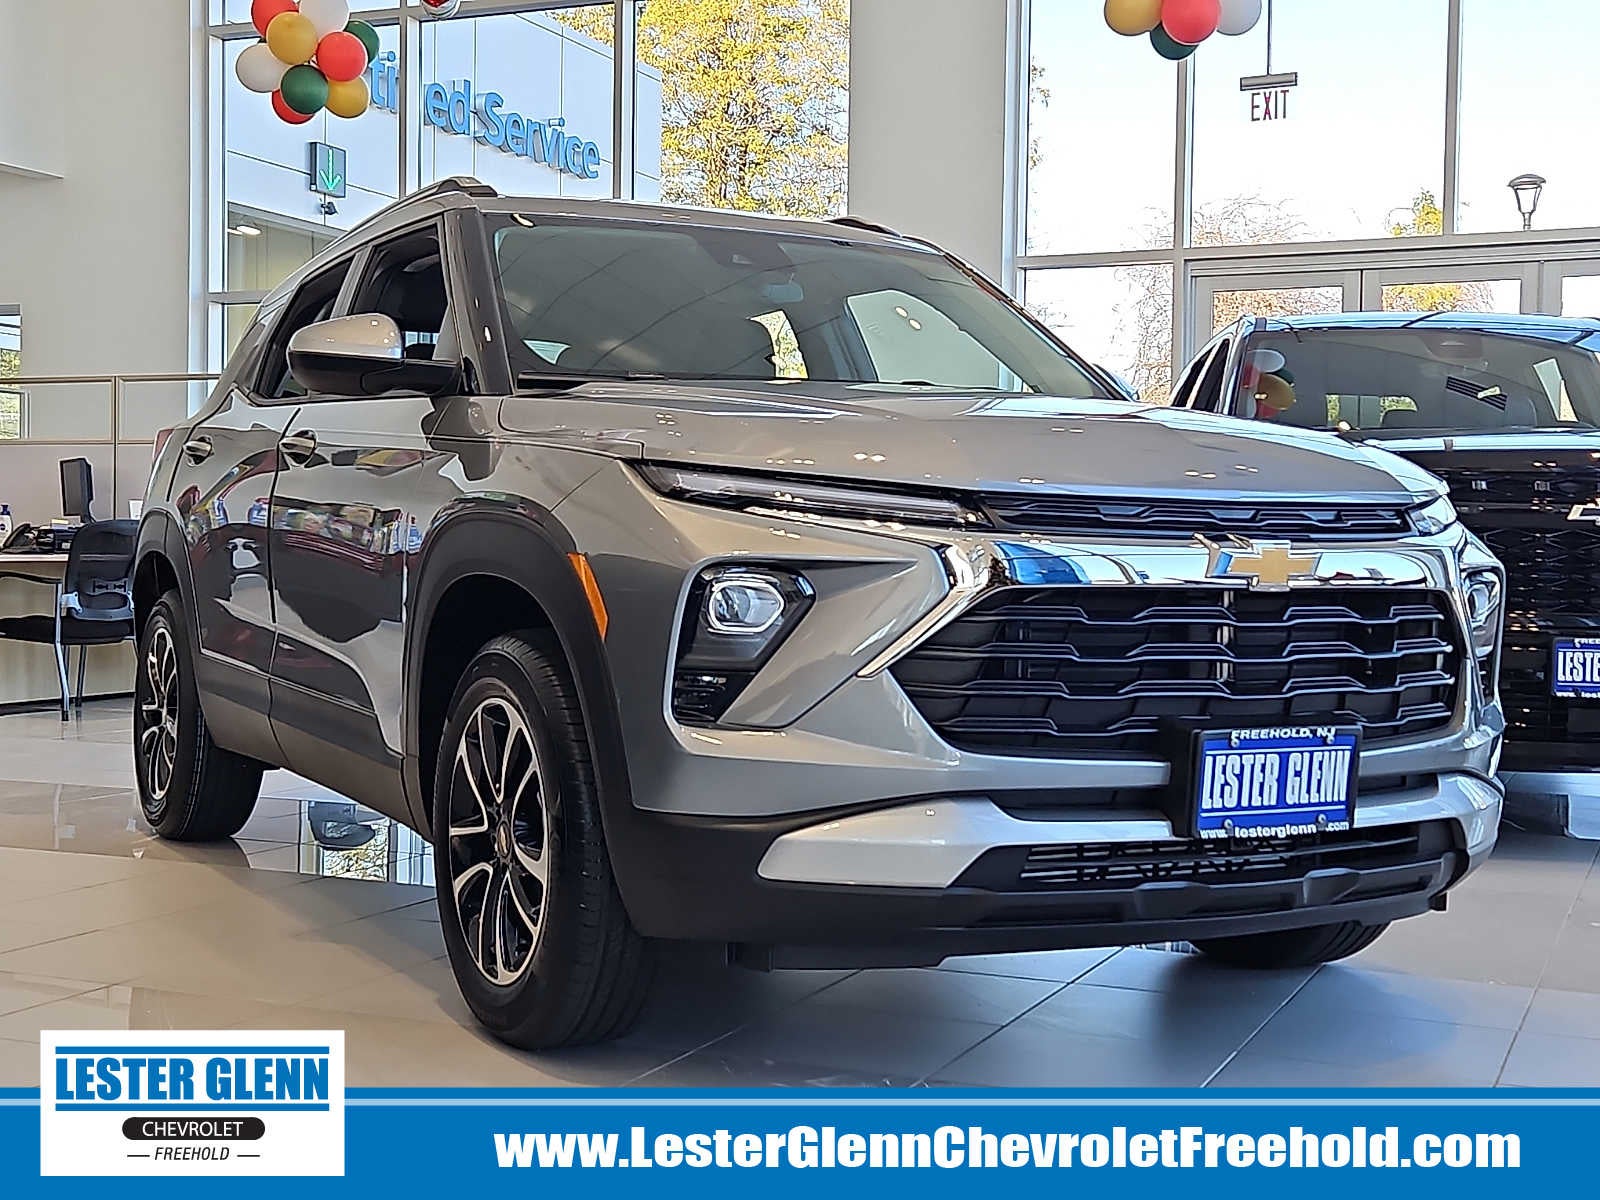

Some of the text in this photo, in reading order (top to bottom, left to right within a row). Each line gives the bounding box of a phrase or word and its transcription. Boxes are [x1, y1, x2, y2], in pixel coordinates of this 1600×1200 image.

[1251, 89, 1290, 121] EXIT
[484, 92, 600, 179] Service
[1557, 651, 1600, 682] LESTE
[1201, 750, 1351, 810] LESTER GLENN
